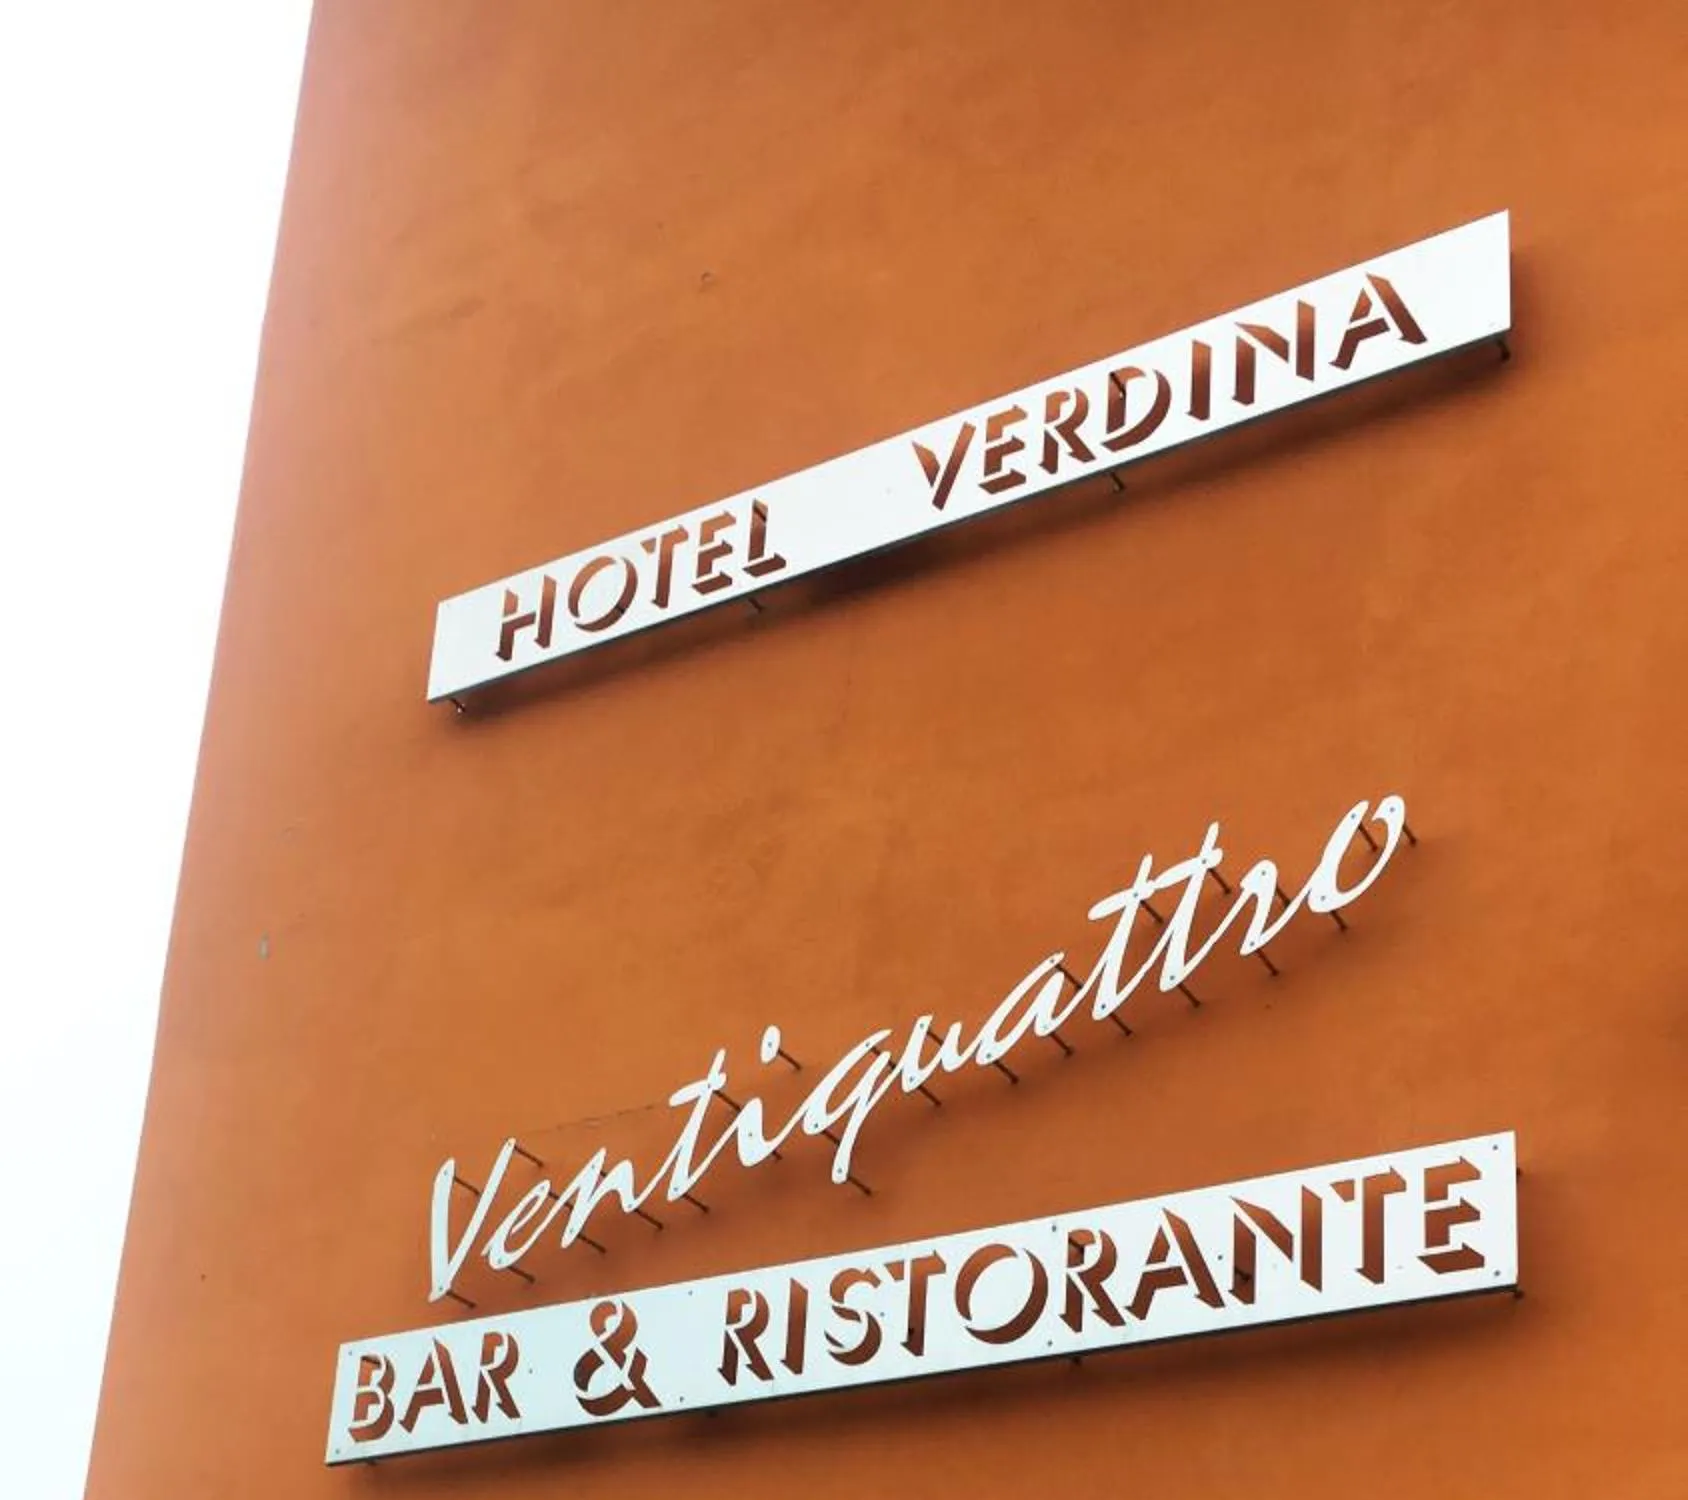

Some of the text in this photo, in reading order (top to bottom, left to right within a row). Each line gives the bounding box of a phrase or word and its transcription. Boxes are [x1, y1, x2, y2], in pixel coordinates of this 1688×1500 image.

[495, 272, 1428, 662] HOTEL VERDINA
[429, 795, 1406, 1302] Ventiquattro
[348, 1155, 1486, 1442] BAR & RISTORANTE
